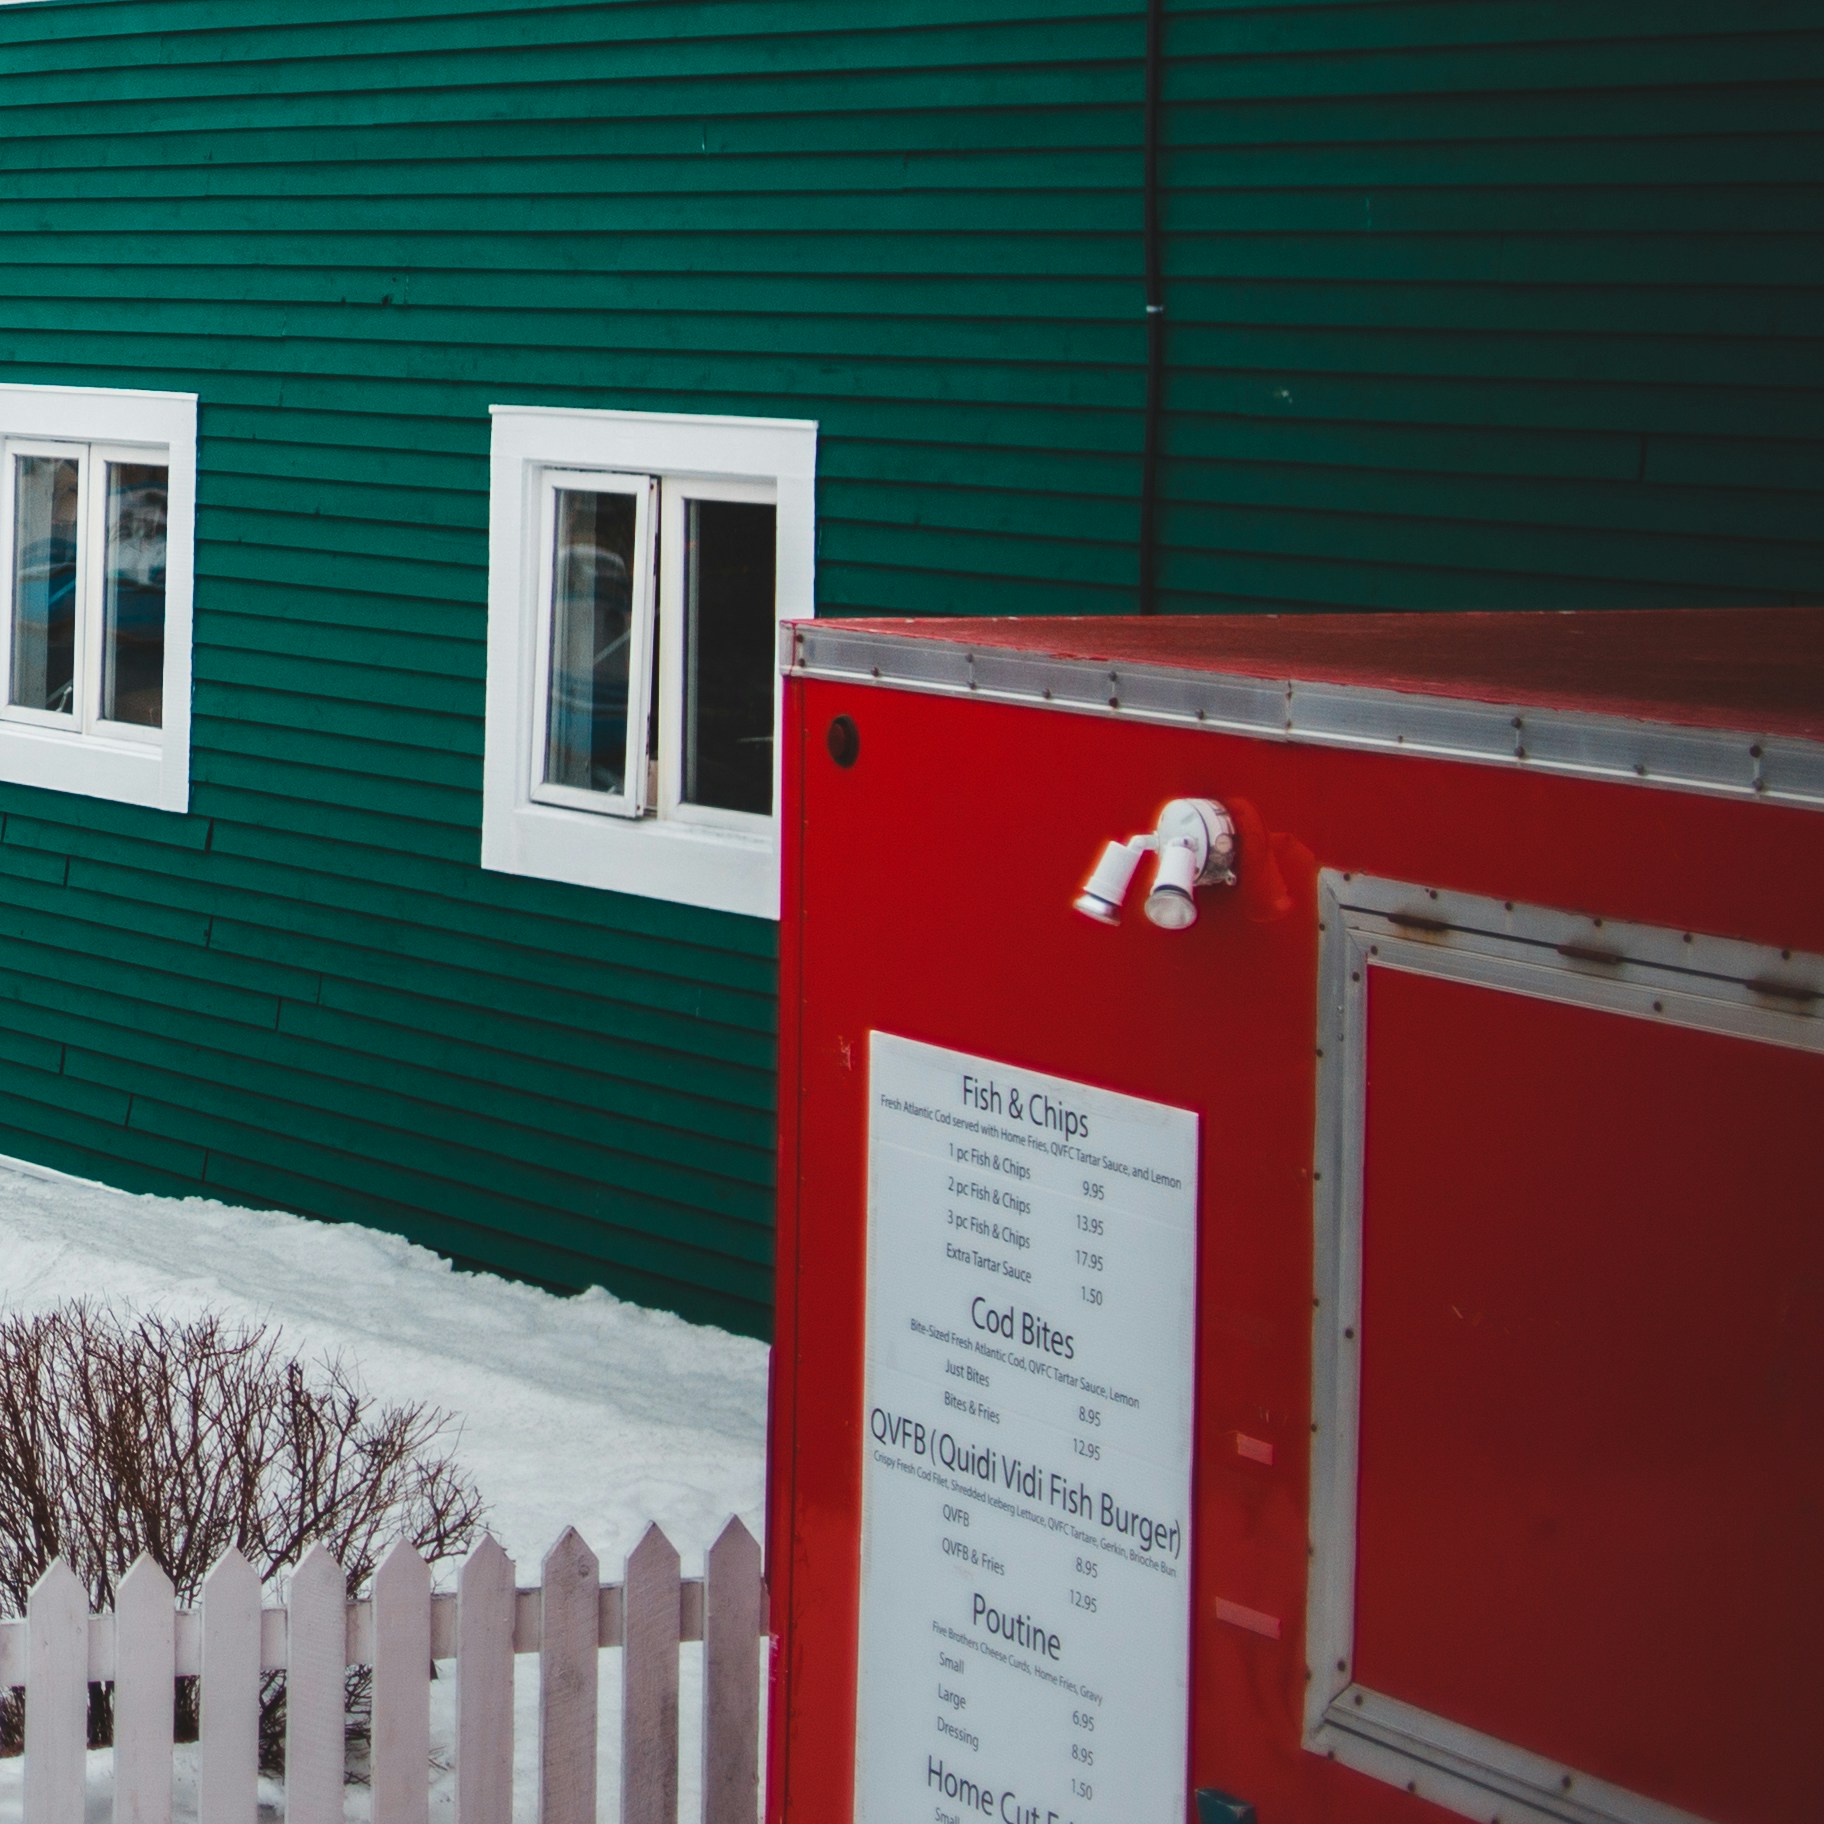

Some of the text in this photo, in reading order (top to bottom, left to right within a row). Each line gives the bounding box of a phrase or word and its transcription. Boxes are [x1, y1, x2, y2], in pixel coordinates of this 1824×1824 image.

[881, 1094, 1182, 1190] Fresh Atlantic Cod served with Home Fries, QVFC Tartar Sauce, and Lemon
[962, 1075, 1089, 1141] Fish & Chips
[948, 1176, 1104, 1236] 2 pc Fish & Chips 13.95
[949, 1142, 1104, 1200] 1 pc Fish & Chips 9.95
[946, 1243, 1102, 1306] Extra Tartar Sauce 1.50
[947, 1210, 1104, 1272] 3 pc Fish & Chips 17.95
[911, 1318, 1140, 1409] Bite-Sized Fresh Atlantic Cod, QVFC Tartar Sauce, Lemon
[971, 1296, 1075, 1360] Cod Bites
[944, 1391, 1100, 1461] Bites & Fries 12.95
[945, 1360, 1101, 1427] Just Bites 8.95
[870, 1408, 1180, 1560] QVFB (Quidi Vidi Fish Burger)
[874, 1450, 896, 1469] Crispy
[897, 1459, 915, 1475] Fresh
[917, 1467, 931, 1482] Cod
[951, 1480, 986, 1502] Shredded
[988, 1494, 1015, 1516] Iceberg
[1017, 1506, 1047, 1527] Lettuce,
[1048, 1517, 1069, 1535] QVFC
[1070, 1527, 1098, 1549] Tartare,
[1100, 1538, 1128, 1560] Gerkin,
[1129, 1549, 1159, 1571] Brioche
[1161, 1561, 1176, 1578] Bun
[942, 1537, 1097, 1613] QVFB & Fries 12.95
[943, 1504, 1098, 1578] QVFB 8.95
[932, 1620, 1103, 1706] Five Brothers Cheese Curds, Home Fries, Gravy
[973, 1593, 1061, 1661] Poutine
[938, 1683, 1094, 1766] Large 8.95
[939, 1651, 1095, 1732] Small 6.95
[928, 1755, 1040, 1824] Home Cut
[937, 1716, 1092, 1801] Dressing 1.50
